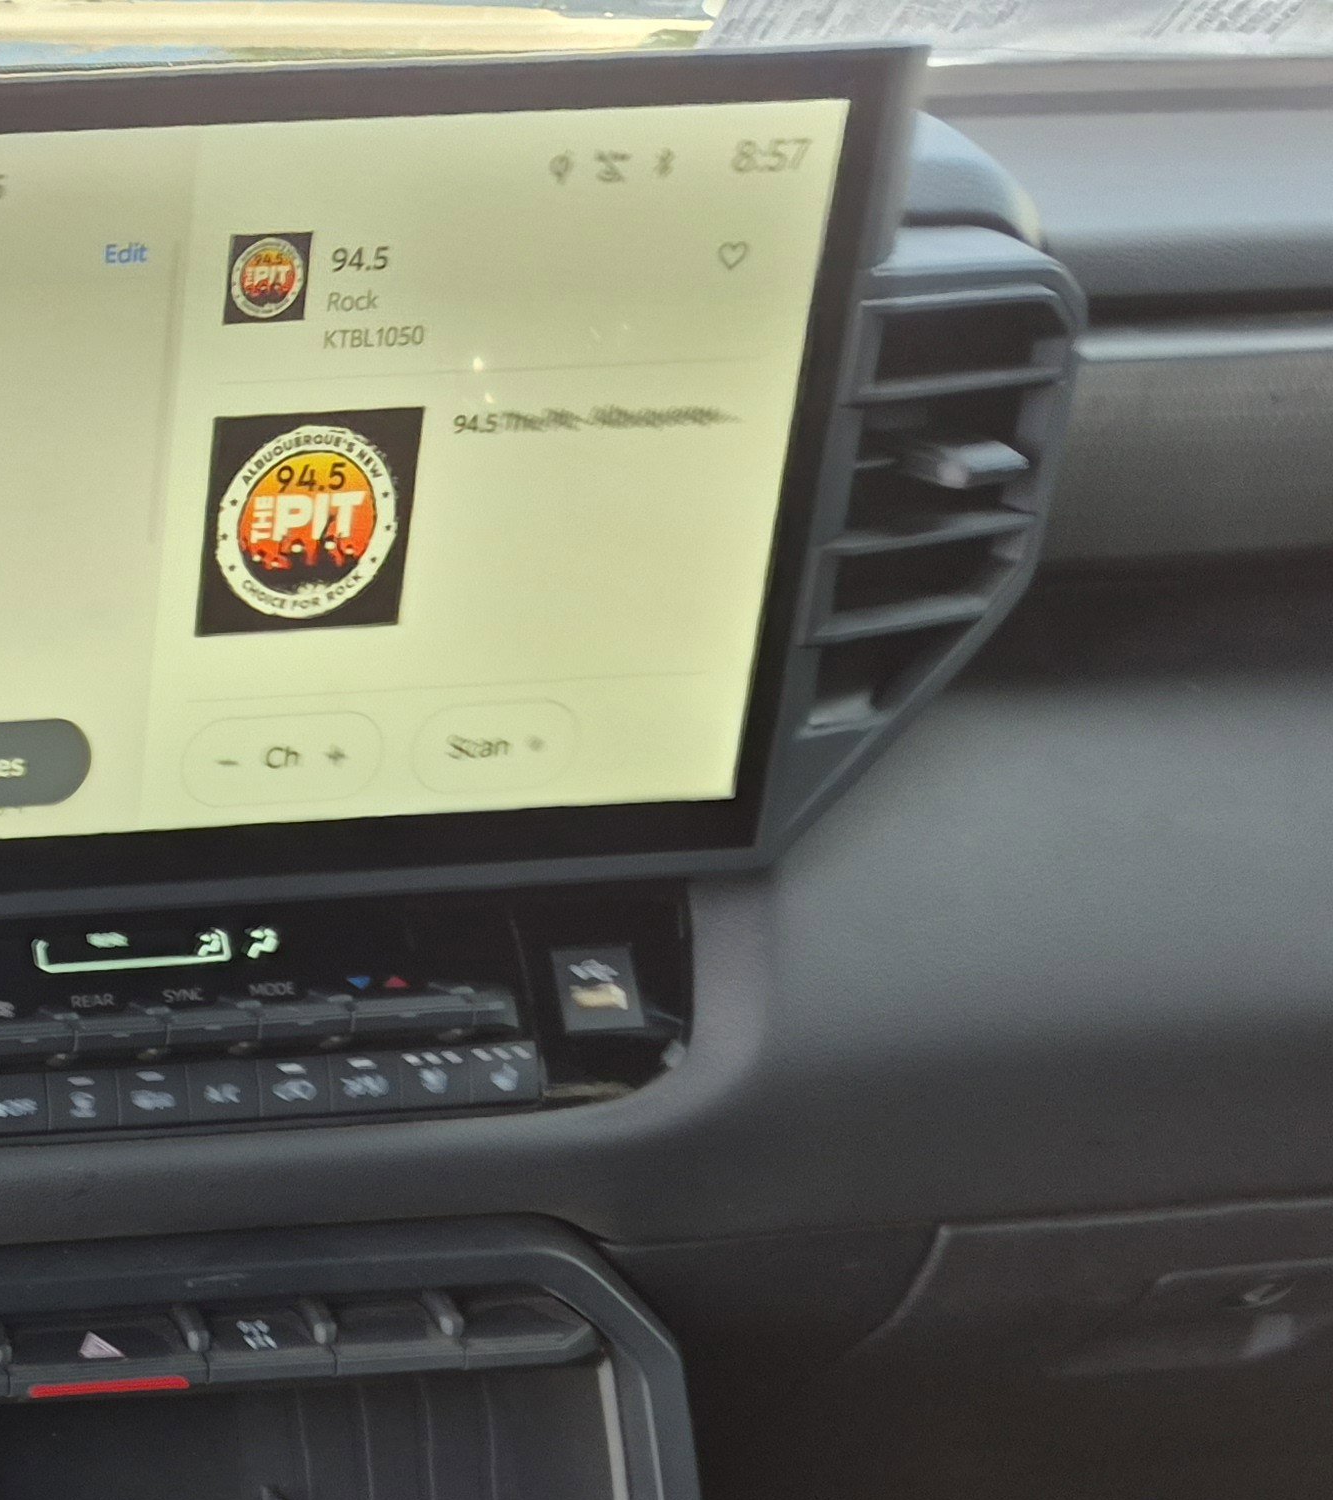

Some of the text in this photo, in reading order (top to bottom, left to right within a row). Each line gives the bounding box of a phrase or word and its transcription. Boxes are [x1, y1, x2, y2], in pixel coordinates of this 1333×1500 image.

[103, 242, 147, 266] Edit
[331, 245, 390, 272] 94.5
[326, 288, 380, 312] Rock
[323, 325, 425, 349] KTBL1050
[452, 412, 499, 434] 94.5
[241, 433, 384, 487] ALBUQUERQUE'S NEW
[276, 461, 347, 493] 94.5
[250, 490, 368, 544] THE PIT
[265, 745, 302, 770] Ch
[445, 735, 511, 760] Scan
[248, 980, 296, 997] MODE
